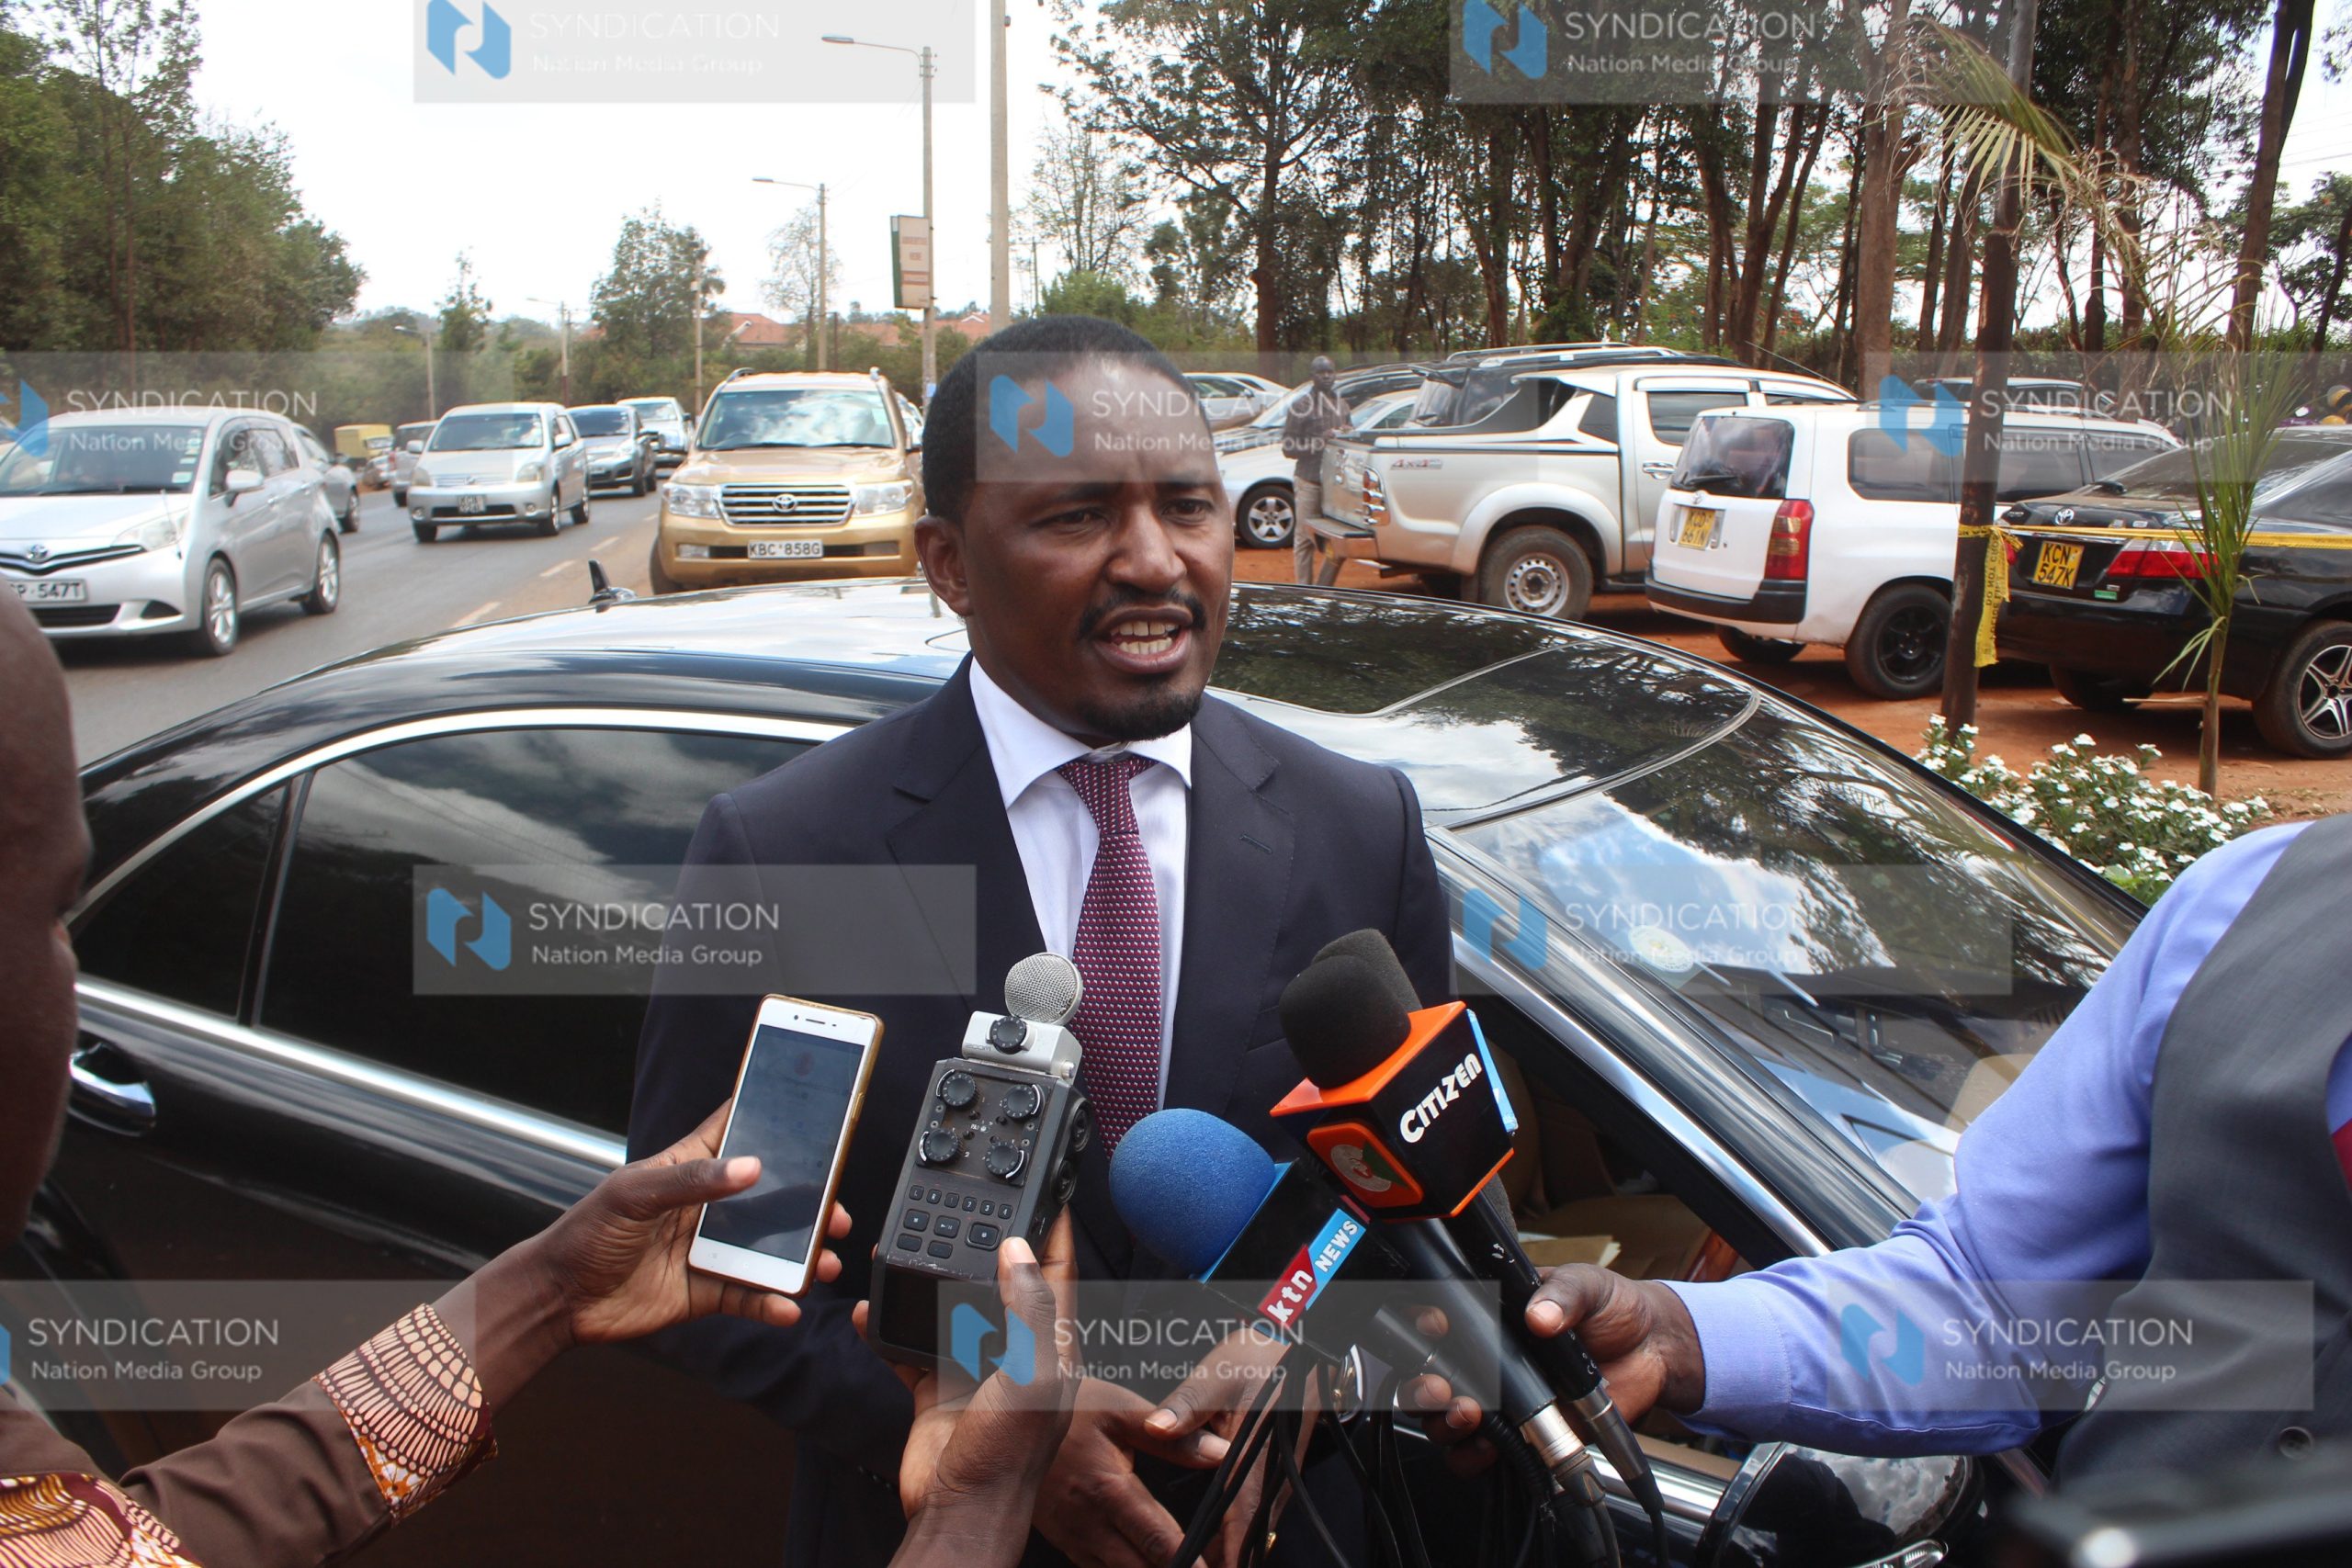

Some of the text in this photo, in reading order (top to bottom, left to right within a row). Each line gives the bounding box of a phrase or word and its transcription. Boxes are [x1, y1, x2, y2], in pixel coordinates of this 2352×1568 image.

[2042, 542, 2072, 565] KCN
[2038, 563, 2075, 588] 547K
[37, 581, 80, 599] 547T
[1399, 1053, 1483, 1144] CITIZEN
[1267, 1220, 1358, 1323] ktn NEWS
